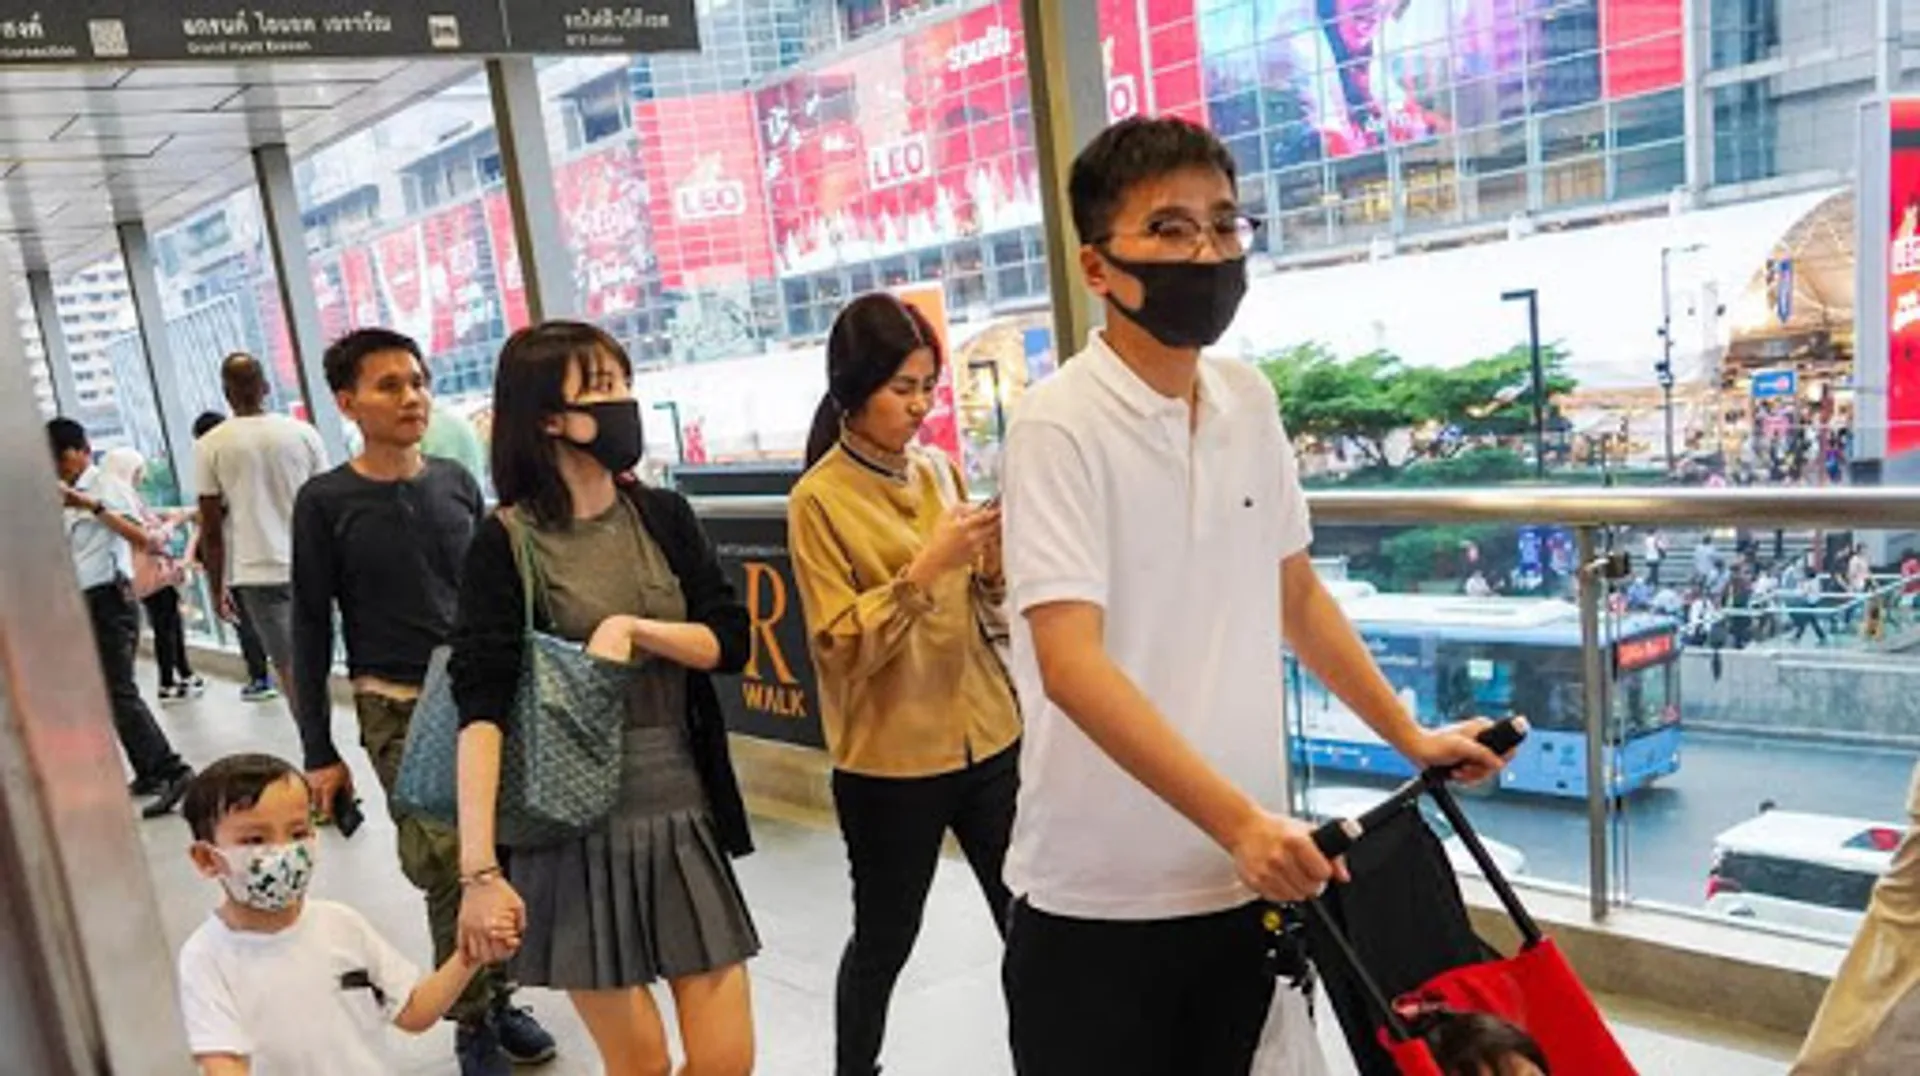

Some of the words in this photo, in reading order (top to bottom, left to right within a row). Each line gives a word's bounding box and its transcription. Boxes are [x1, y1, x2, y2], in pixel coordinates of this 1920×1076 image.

[873, 141, 924, 184] LEO
[682, 187, 740, 214] LEO
[742, 561, 799, 685] R
[742, 683, 808, 718] WALK
